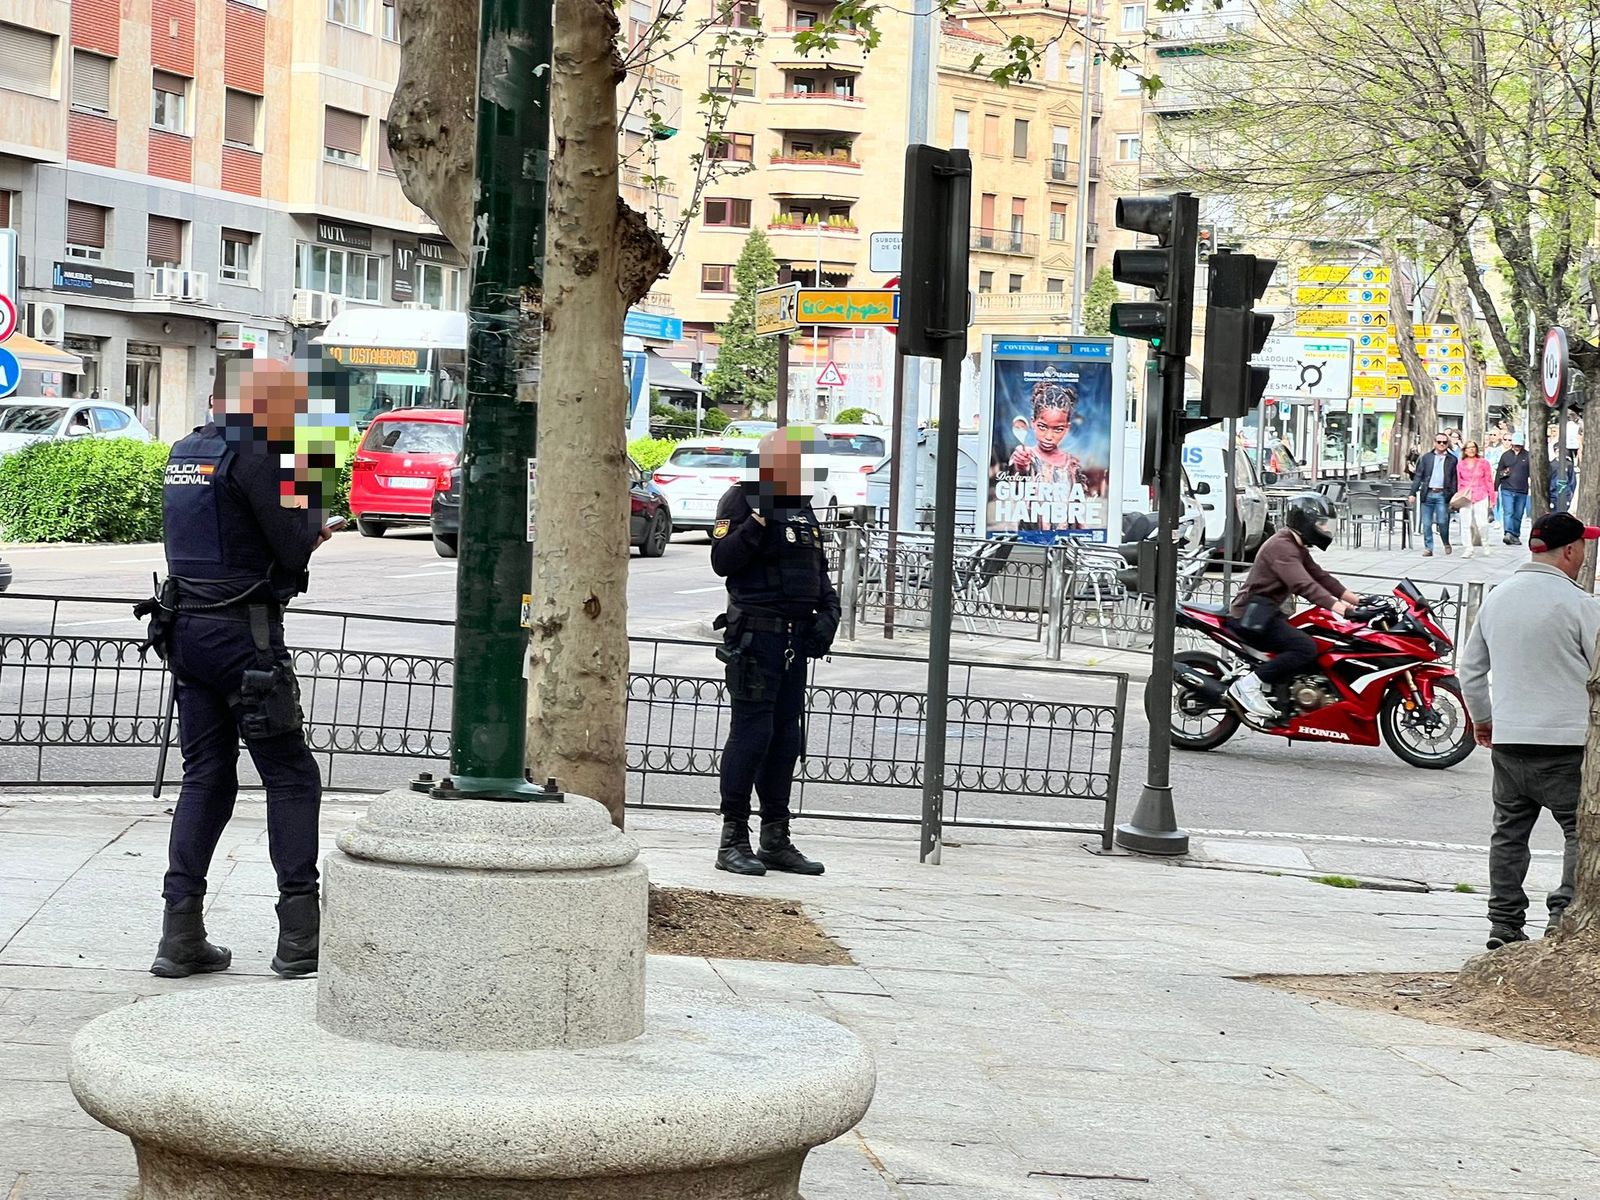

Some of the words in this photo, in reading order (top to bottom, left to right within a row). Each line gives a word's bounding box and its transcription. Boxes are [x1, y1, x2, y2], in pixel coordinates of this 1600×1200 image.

[1003, 344, 1049, 352] CONTENEDOR
[349, 347, 417, 366] VISTAHERMOSA
[1251, 355, 1294, 363] ALLADOLID
[1182, 447, 1203, 464] IS
[163, 474, 210, 486] NACIONAL
[996, 471, 1032, 481] Declara
[995, 481, 1086, 502] GUERRA
[995, 500, 1102, 524] HAMBRE
[1298, 725, 1350, 741] HONDA
